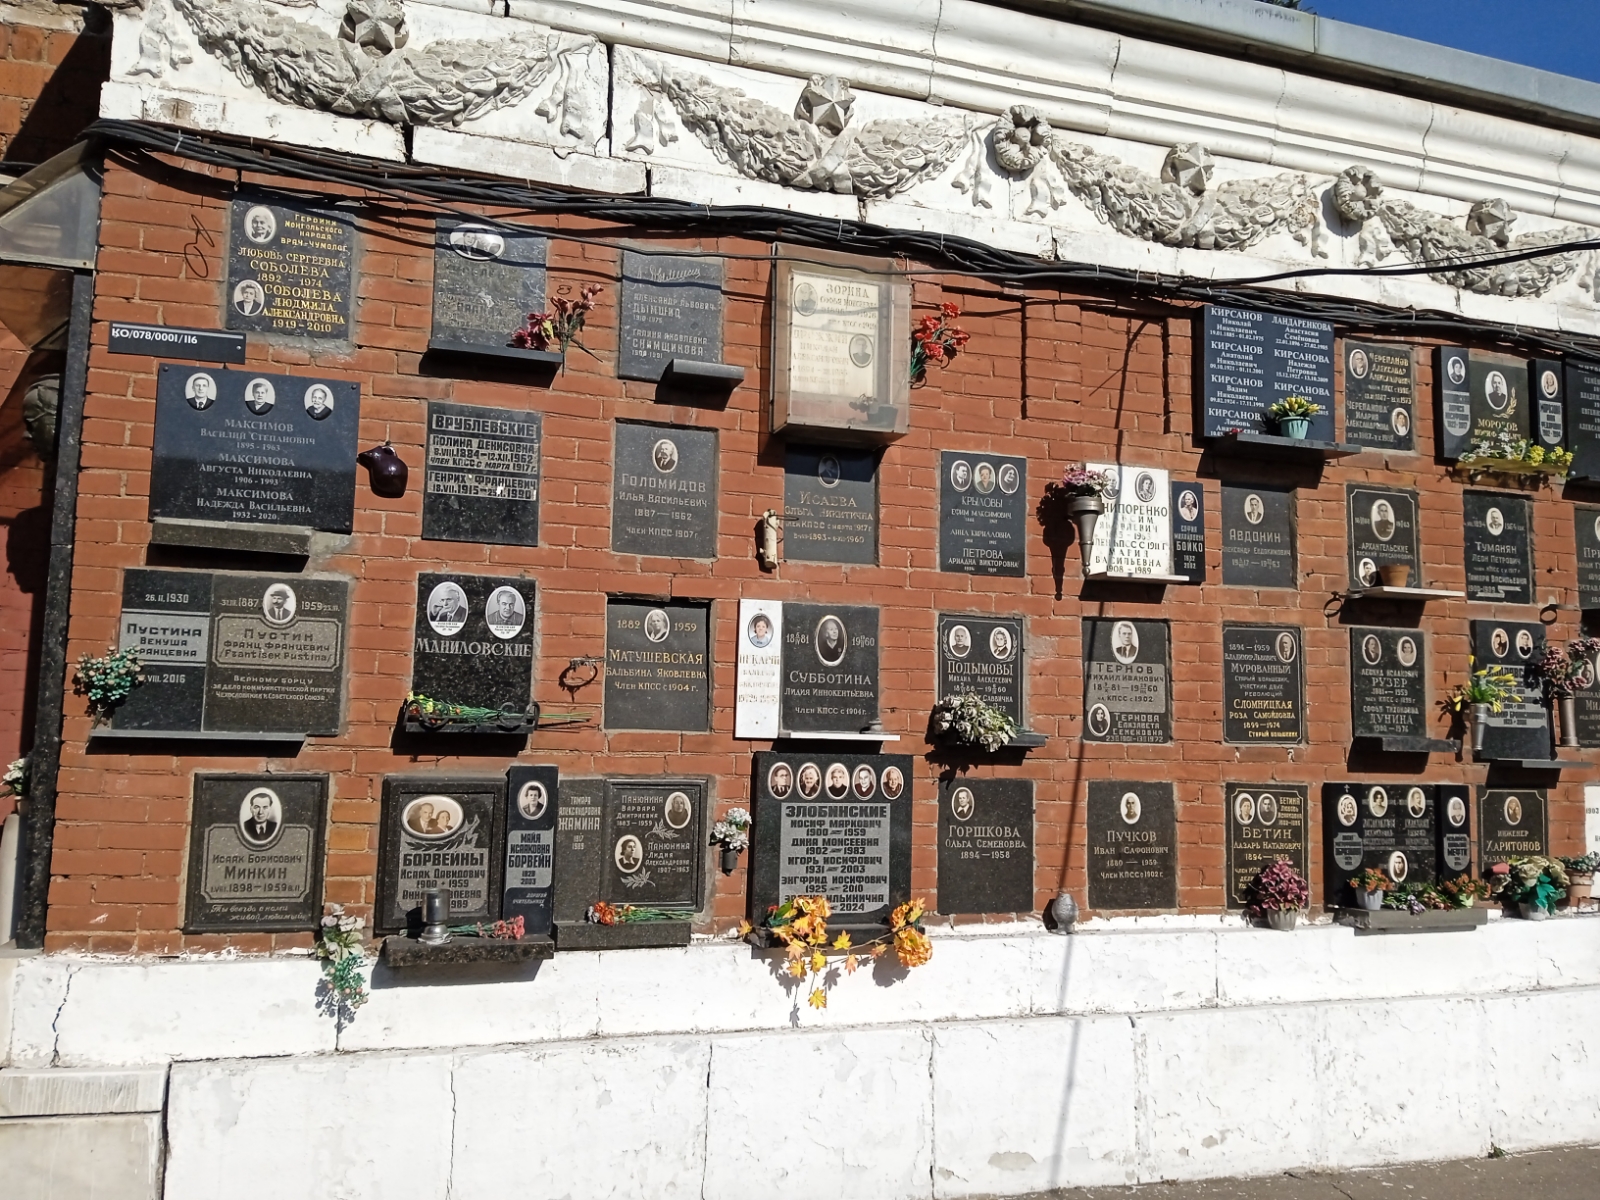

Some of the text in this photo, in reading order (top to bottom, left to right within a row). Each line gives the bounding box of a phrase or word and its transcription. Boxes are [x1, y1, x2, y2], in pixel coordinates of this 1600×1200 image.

[238, 247, 345, 268] ЛЮБОВЬ СЕРГЕЕВНА
[250, 260, 330, 278] СОБОЛЕВА
[257, 273, 323, 287] 1892 1974
[264, 284, 342, 302] СОБОЛЕВА
[273, 298, 334, 312] ЛЮДМИЛА
[262, 307, 345, 324] АЛЕКСАНДРОВНА
[1211, 308, 1262, 322] КИРСАНОВ
[307, 323, 331, 332] 2010
[1211, 341, 1263, 354] КИРСАНОВ
[1274, 349, 1330, 364] КИРСАНОВА
[1211, 374, 1263, 387] КИРСАНОВ
[1274, 382, 1330, 396] КИРСАНОВА
[224, 419, 294, 432] МАКСИМОВ
[435, 415, 535, 437] ВРУБЛЕВСКИЕ
[1478, 418, 1518, 431] МОРООВ
[433, 436, 535, 454] ПОЛИНА ДЕНИСОВНА
[218, 453, 295, 466] МАКСИМОВА
[260, 478, 279, 486] 1993
[429, 472, 536, 489] ГЕНРИХ ФРАНЦЕВИЧ
[216, 488, 293, 501] МАКСИМОВА
[232, 511, 251, 519] 1932
[648, 528, 672, 536] КПСС
[963, 548, 1003, 559] ПЕТРОВА
[617, 620, 697, 632] 1882 1959
[139, 647, 197, 657] РАНЦЕВНА
[163, 674, 186, 684] 2016
[638, 683, 661, 691] КПСС
[786, 806, 887, 818] ЗЛОБИНСКИЕ
[559, 818, 600, 830] ЖАМИНА
[791, 820, 881, 828] ИОСИФ МАРКОВИЧ
[844, 828, 866, 836] 1959
[791, 838, 818, 846] ДИНА
[844, 847, 866, 855] 1983
[991, 851, 1010, 859] 1958
[403, 851, 484, 867] БОРВЕЙНЫ
[508, 854, 551, 868] БОРВЕЙН
[788, 857, 882, 865] ИГОРЬ ИОСИФОВИЧ
[840, 865, 866, 873] 2003
[448, 880, 469, 888] 1959
[781, 876, 887, 884] ЭНГФРИД ИОСИФОВИЧ
[840, 903, 865, 911] 2024
